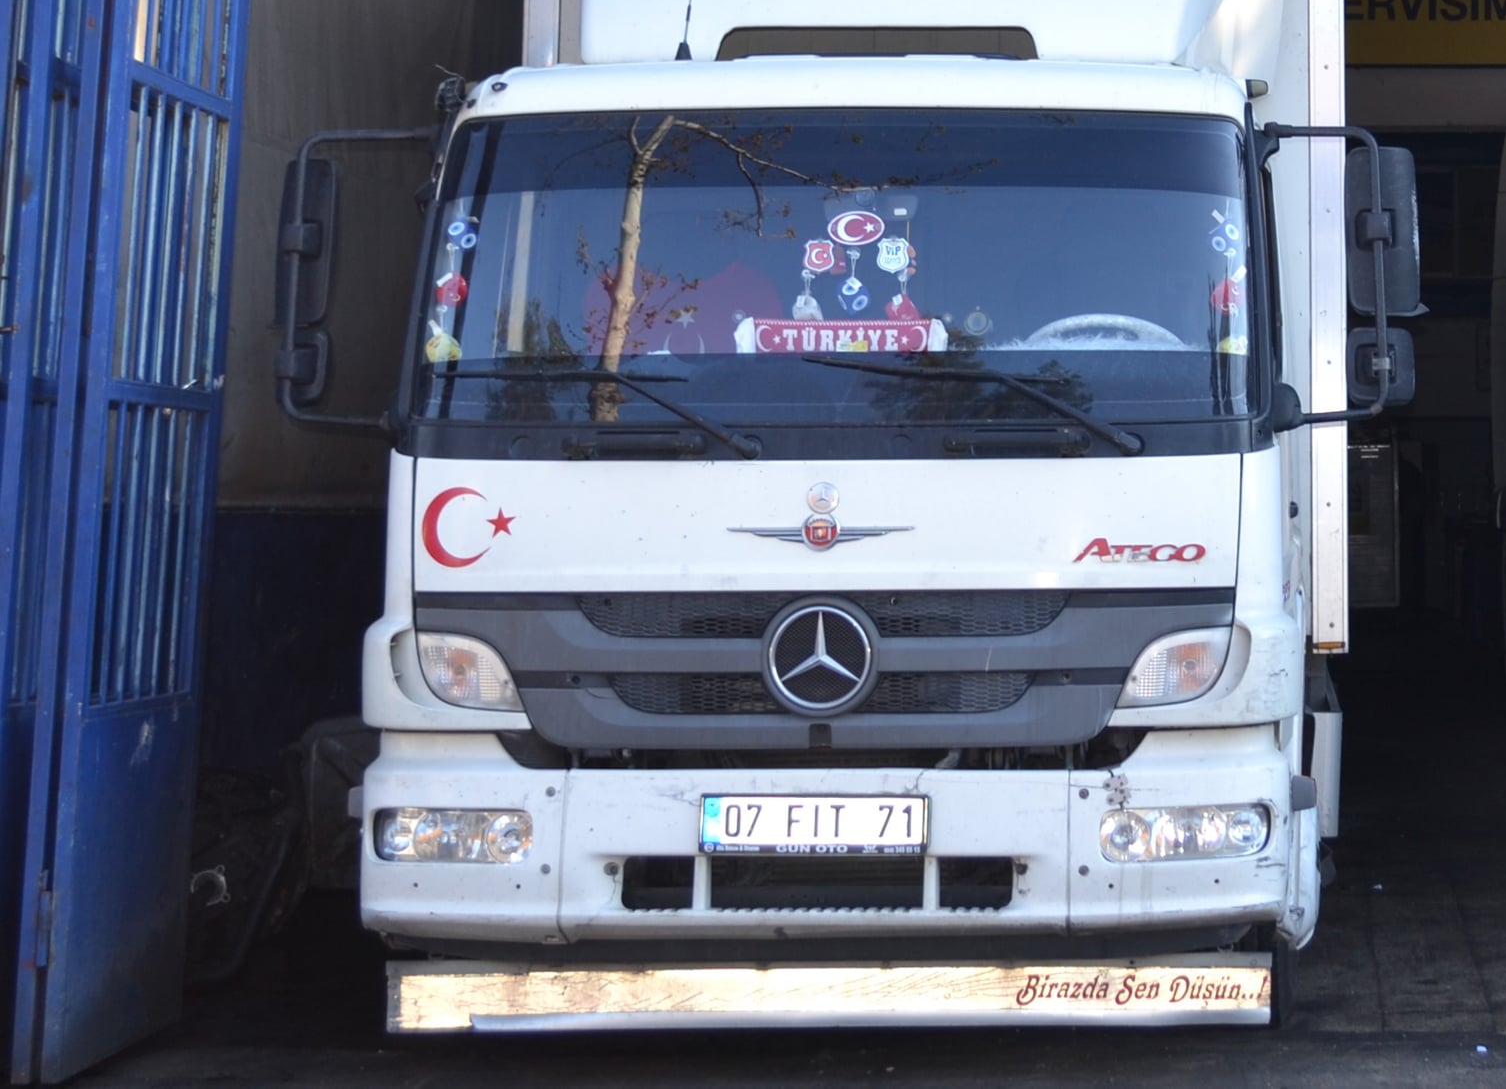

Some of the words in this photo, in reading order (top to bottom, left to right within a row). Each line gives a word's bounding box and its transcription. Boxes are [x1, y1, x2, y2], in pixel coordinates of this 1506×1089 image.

[782, 326, 899, 351] TÜRKİYE
[1072, 537, 1207, 563] ATEGO
[725, 804, 762, 838] 07
[787, 804, 845, 838] FIT
[878, 804, 913, 838] 71
[1015, 974, 1110, 1006] Birazda
[1115, 974, 1160, 1006] Sen
